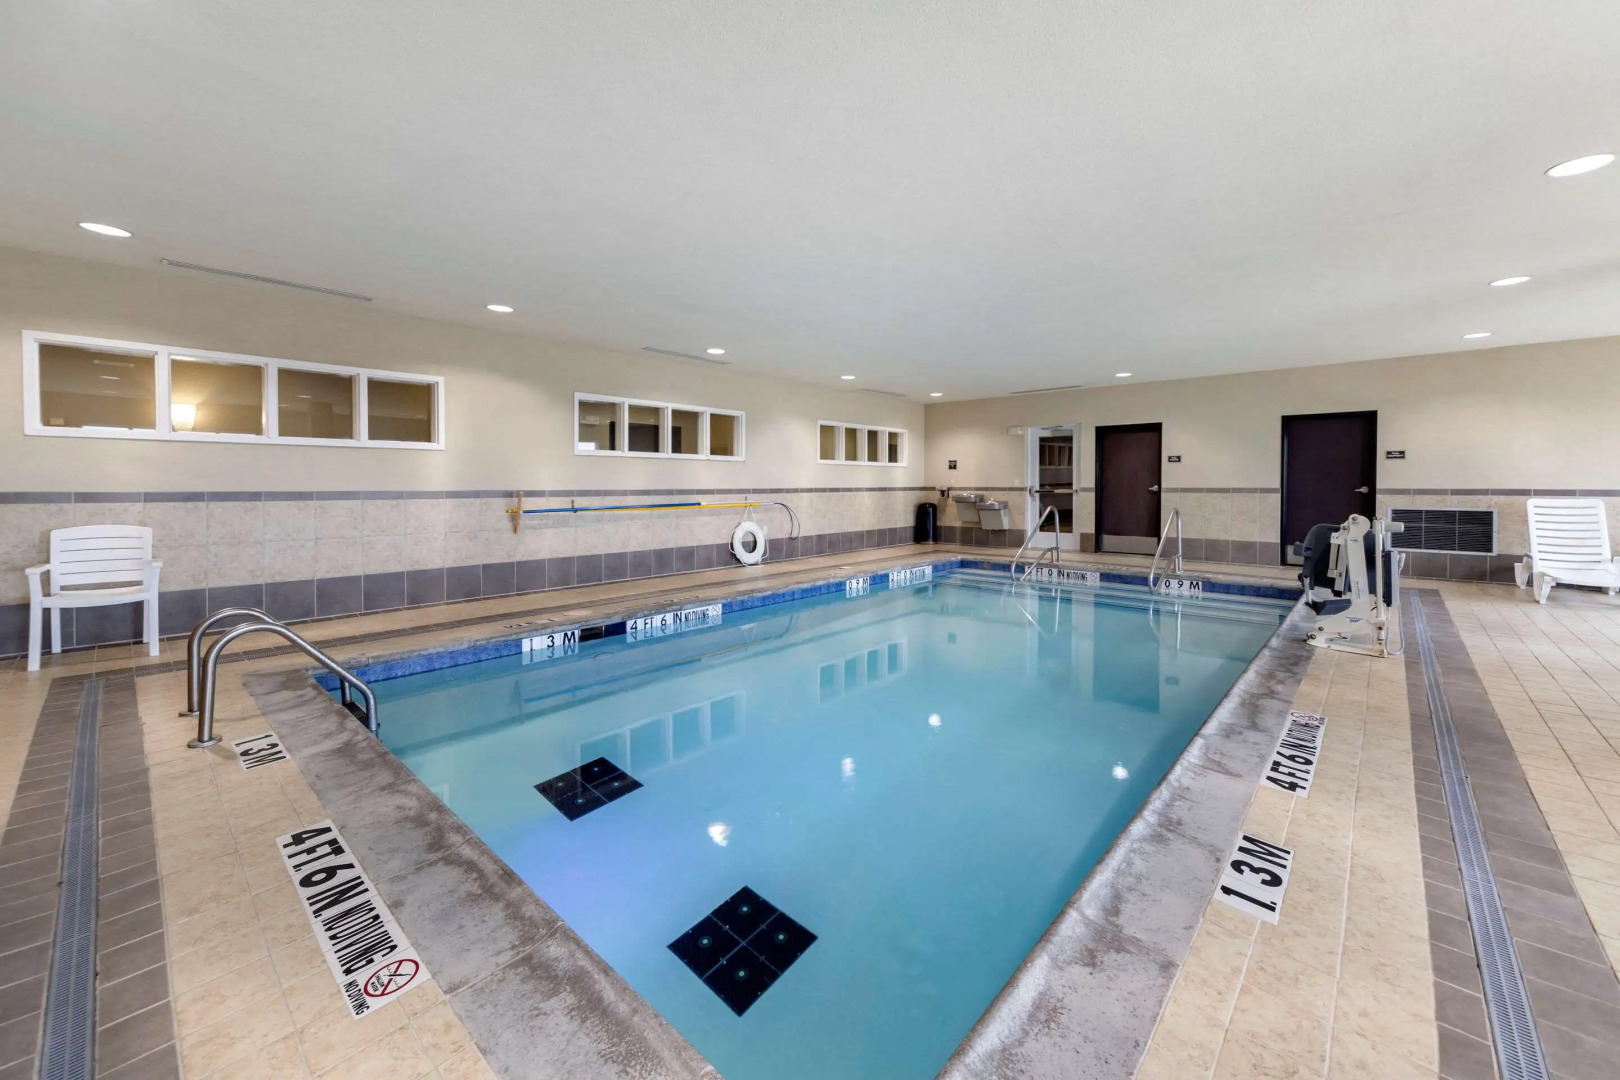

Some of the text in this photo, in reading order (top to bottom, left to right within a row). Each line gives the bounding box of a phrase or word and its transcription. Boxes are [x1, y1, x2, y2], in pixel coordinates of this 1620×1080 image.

[630, 619, 638, 630] 4
[644, 617, 655, 629] FT
[660, 614, 667, 626] 6
[1276, 750, 1314, 766] 6
[1265, 775, 1307, 792] 4
[282, 826, 333, 849] 4
[298, 863, 356, 888] 6
[321, 899, 377, 932] NO
[328, 913, 398, 977] DIVING
[343, 978, 370, 1016] NO DIVING
